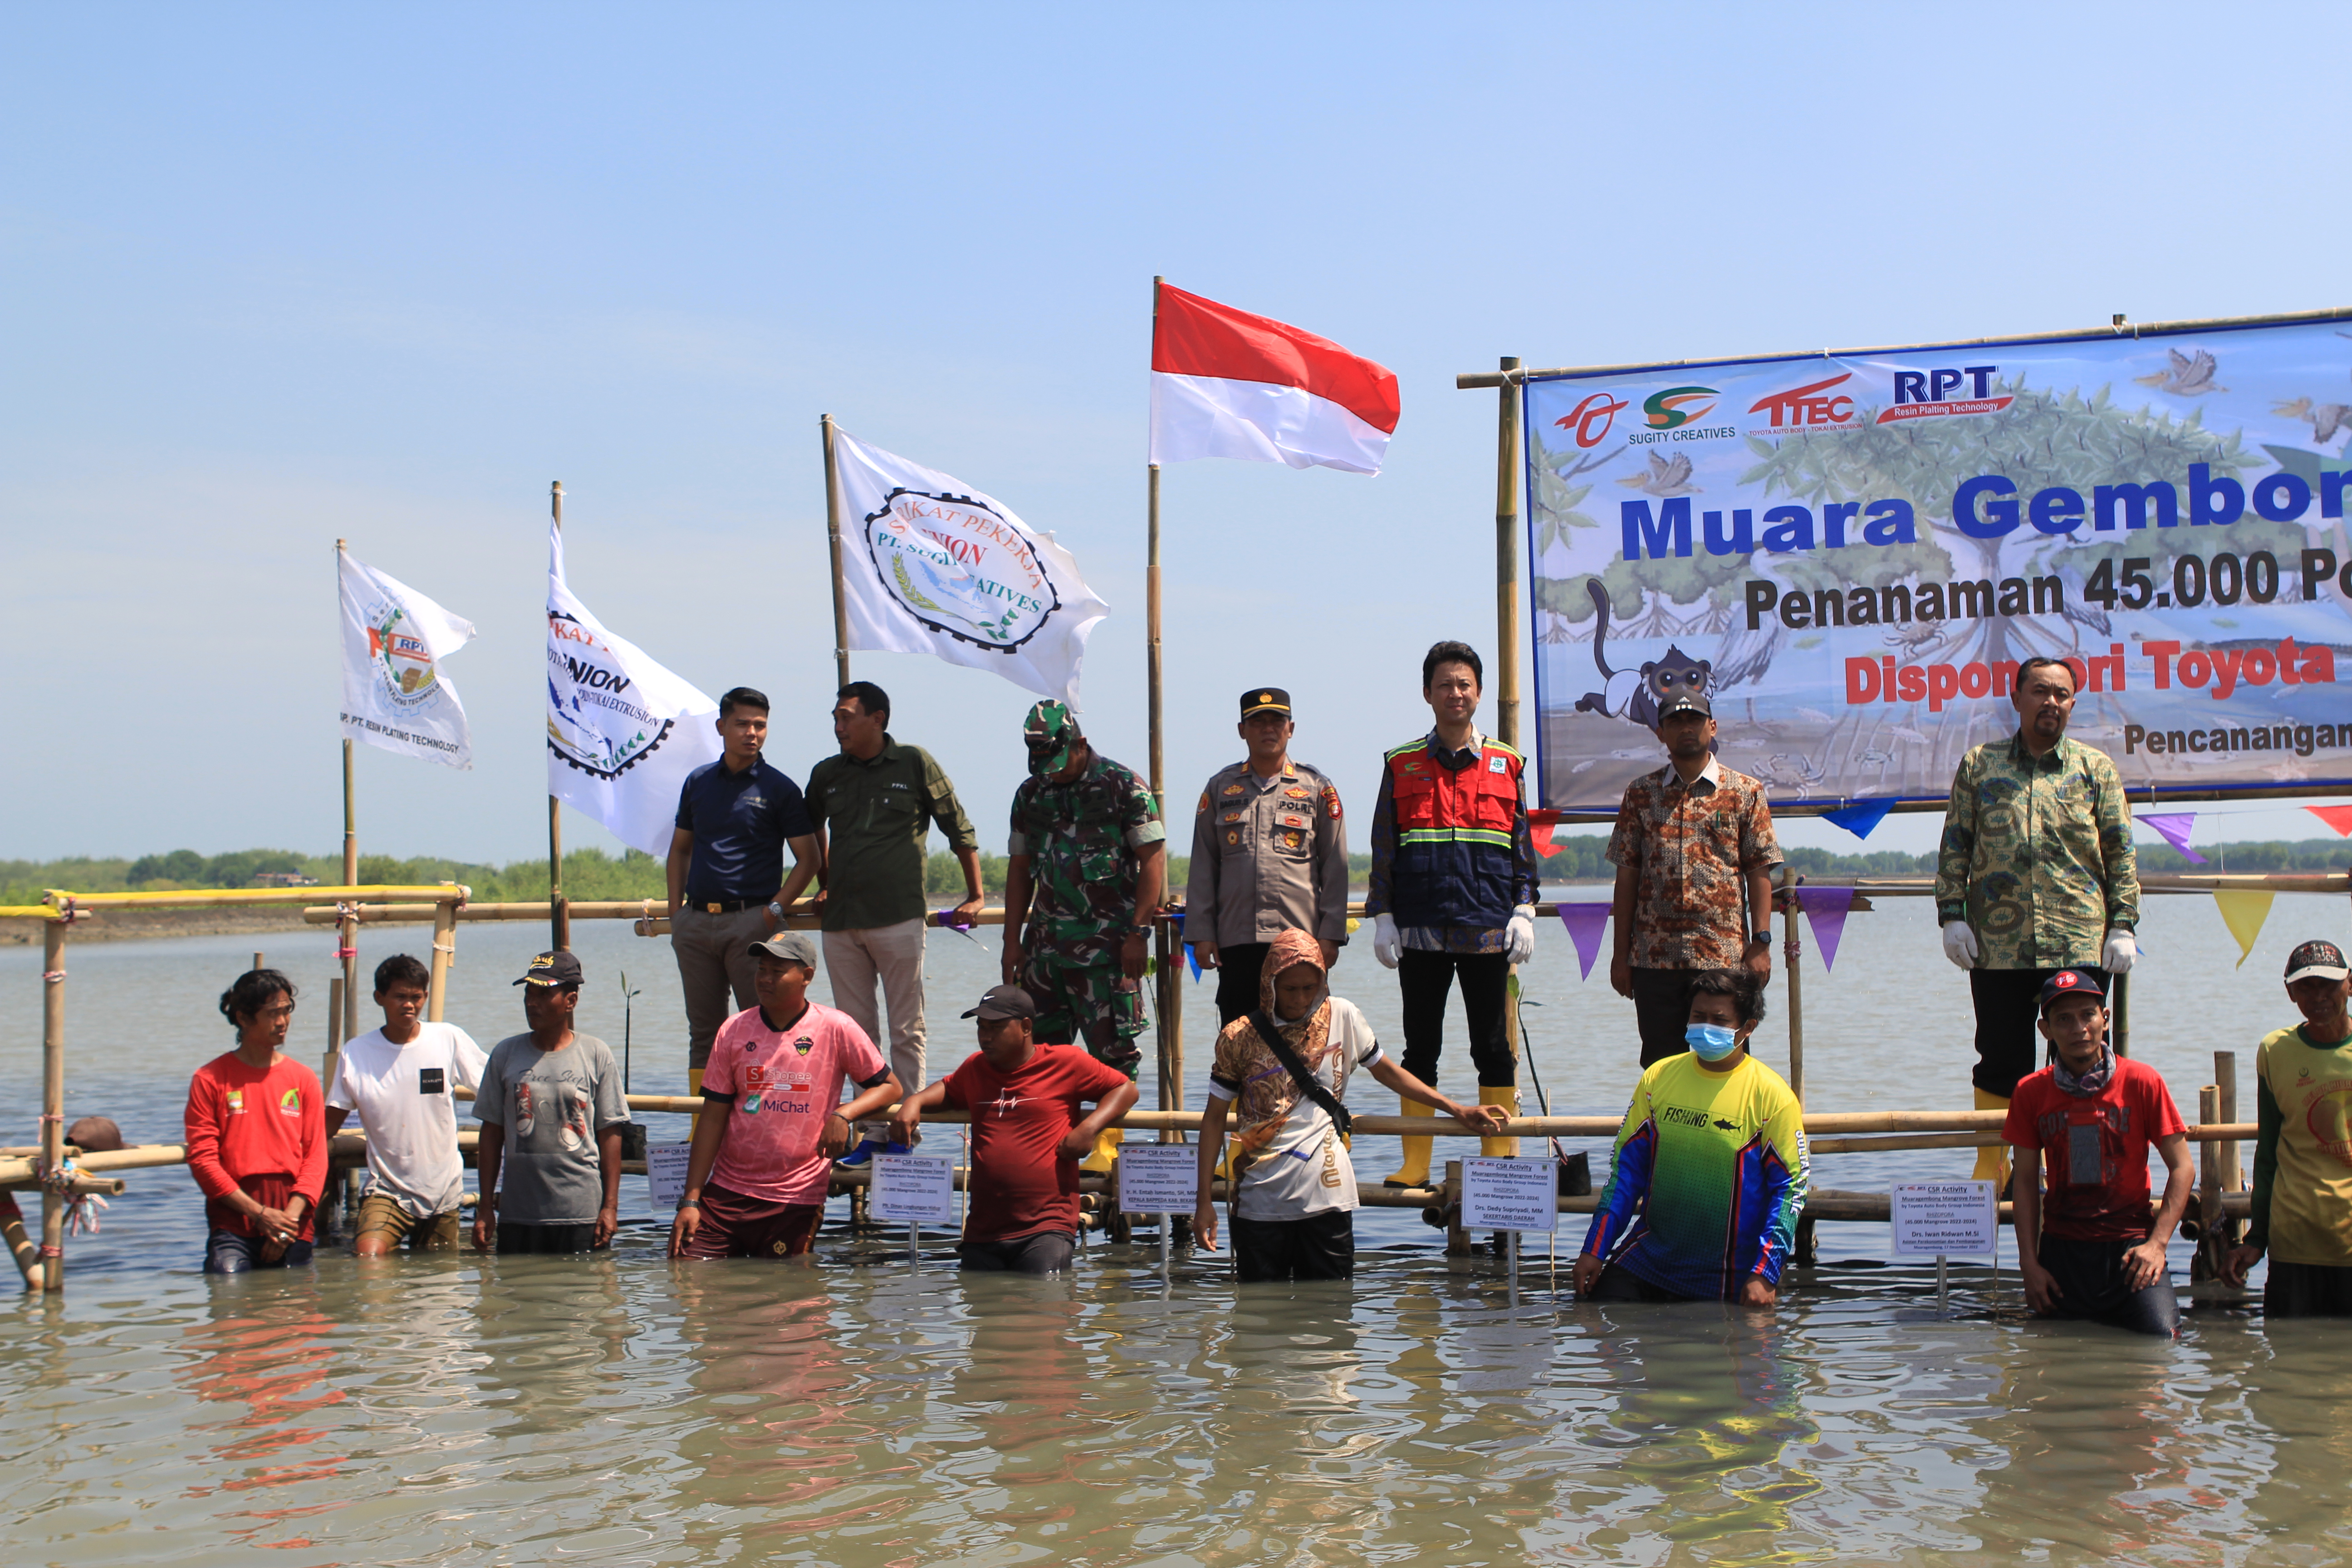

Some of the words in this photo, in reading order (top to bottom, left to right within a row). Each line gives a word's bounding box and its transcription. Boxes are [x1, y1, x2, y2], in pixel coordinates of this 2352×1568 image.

[1894, 365, 1998, 404] RPT
[1894, 406, 1918, 416] Resin
[1951, 401, 1999, 413] Technology
[1629, 431, 1670, 445] SUGITY
[1672, 426, 1736, 442] CREATIVES
[1830, 422, 1862, 431] EXTRUSION
[1621, 495, 1916, 561] Muara
[877, 532, 902, 548] PT.
[922, 528, 988, 567] NION
[962, 514, 1043, 590] PEKERJA
[1745, 574, 2064, 631] Penanaman
[2084, 550, 2279, 610] 45.000
[564, 652, 631, 694] NION
[1845, 643, 2126, 712] Disponri
[2142, 636, 2336, 700] Toyota
[407, 683, 441, 706] TECHNOLO
[608, 696, 660, 727] EXTRUSION
[351, 715, 364, 727] PT.
[365, 719, 381, 733] RESIN
[382, 725, 410, 742] PLATING
[411, 734, 459, 755] TECHNOLOGY
[1279, 800, 1313, 814] POLRI
[519, 1068, 551, 1083] Free
[766, 1067, 812, 1083] Shopee
[763, 1100, 810, 1113] MiChat
[1663, 1107, 1709, 1128] FISHING
